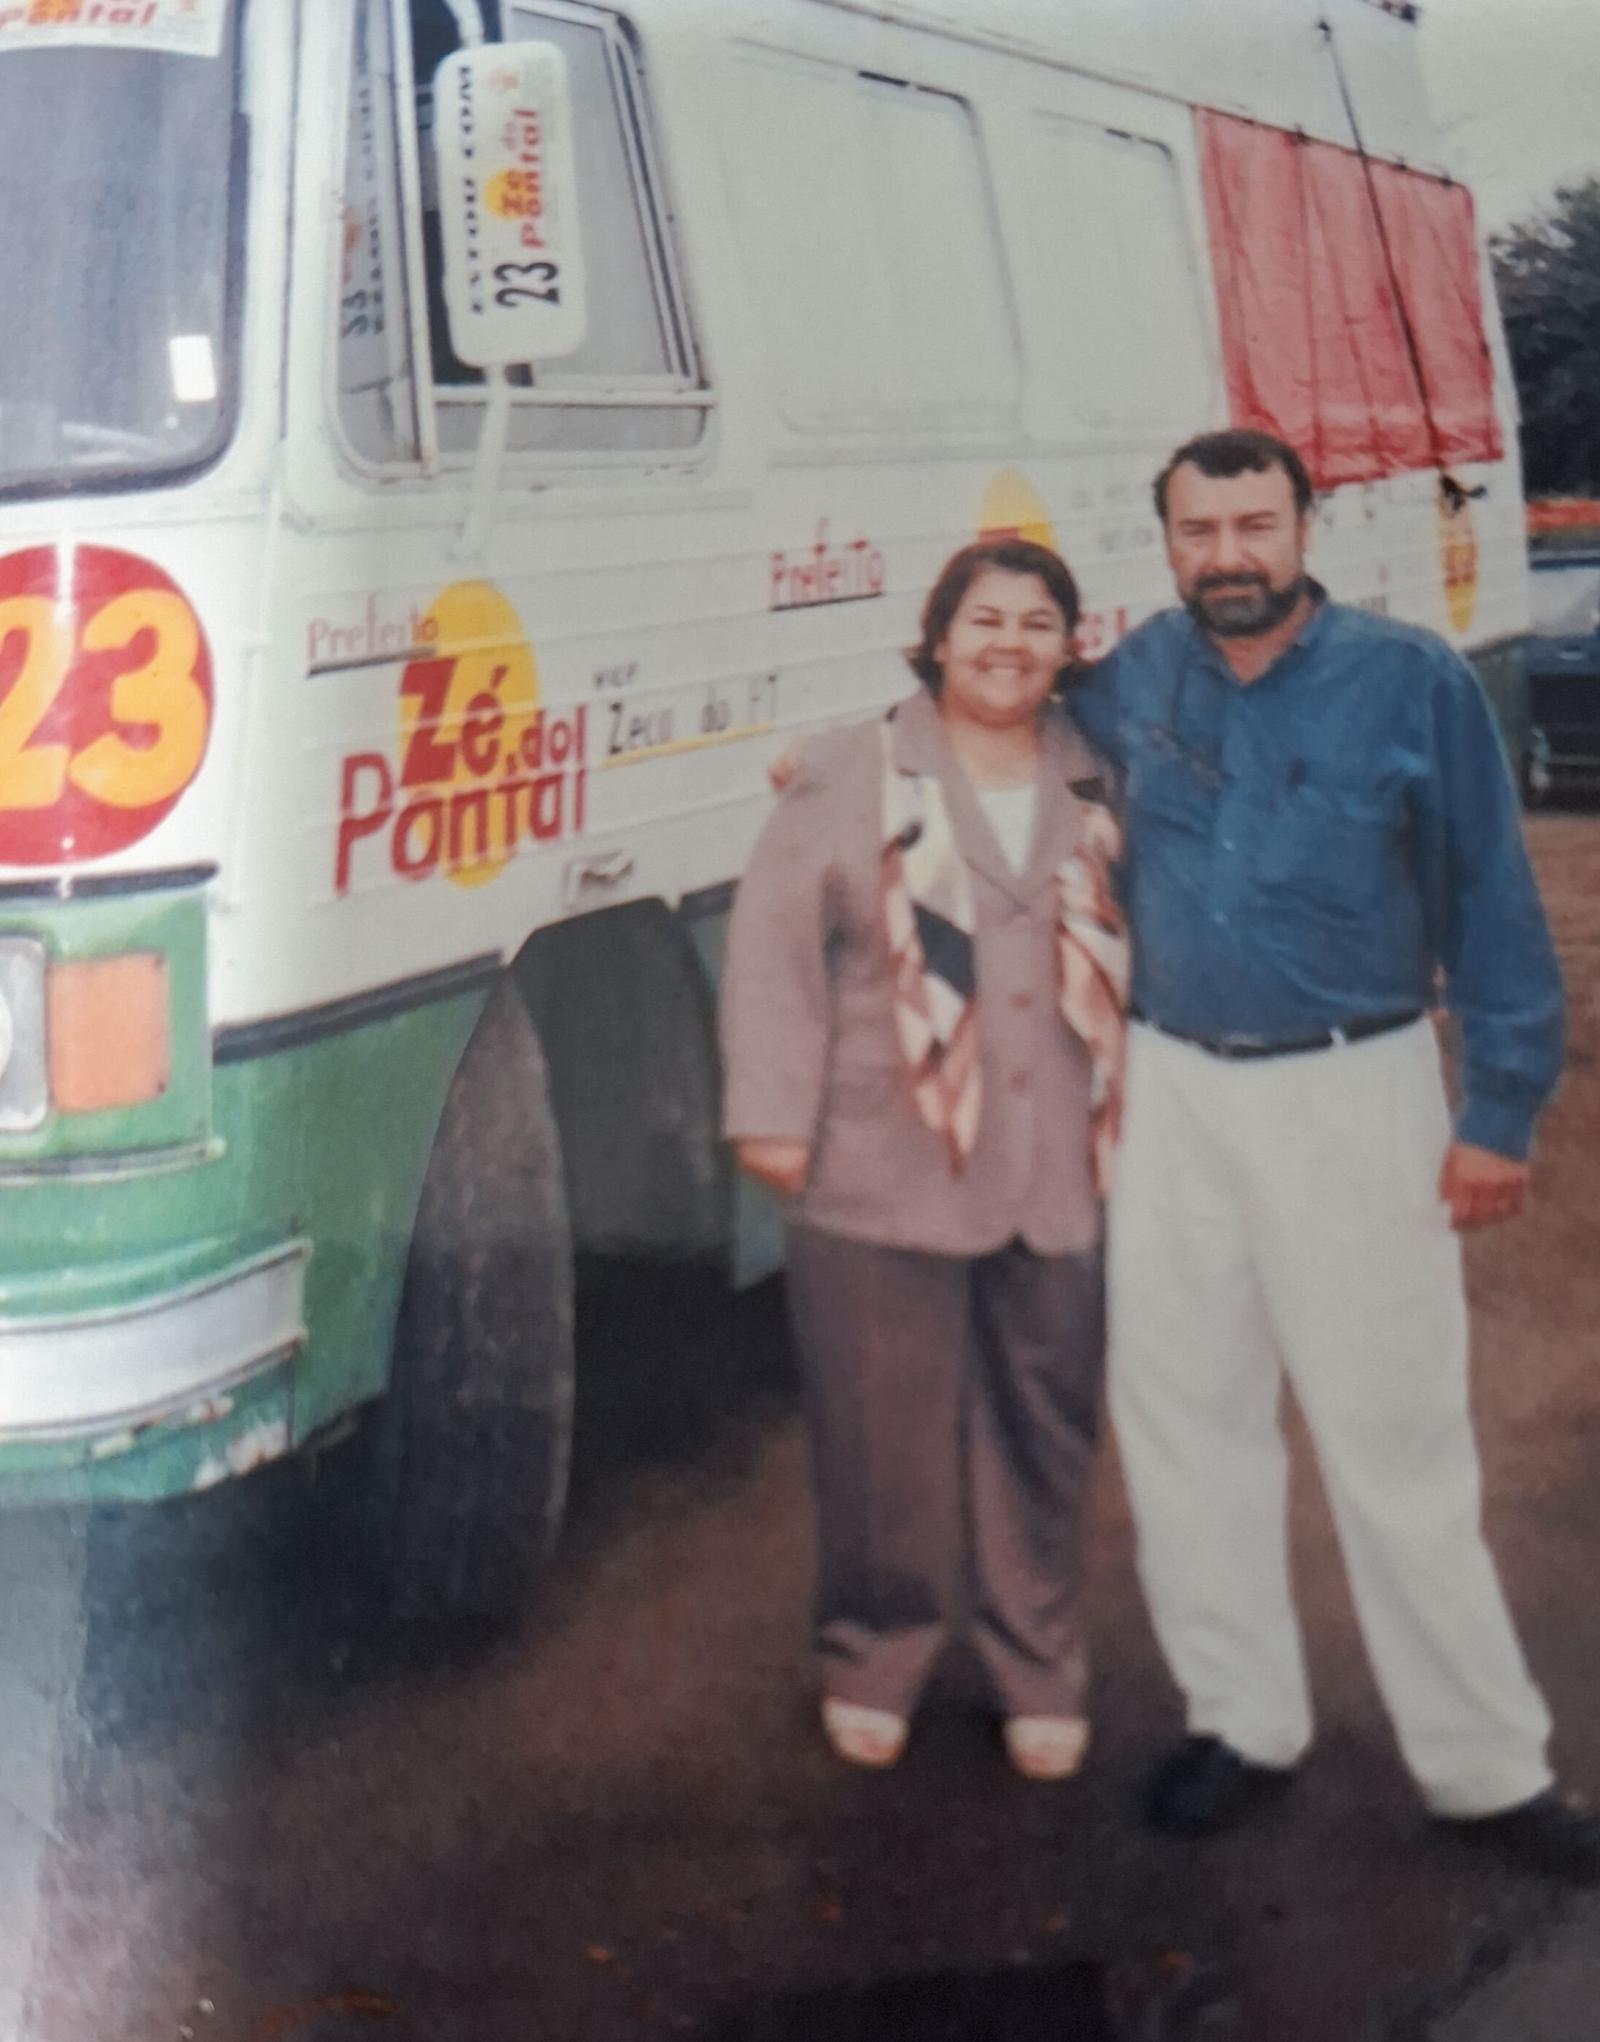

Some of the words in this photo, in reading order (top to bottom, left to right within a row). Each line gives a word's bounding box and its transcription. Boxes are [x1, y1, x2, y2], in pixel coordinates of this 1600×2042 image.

[493, 261, 562, 309] 23
[768, 515, 886, 606] Prefeito
[305, 591, 440, 663] Prefeito
[0, 587, 207, 810] 23
[399, 653, 510, 788] Zé
